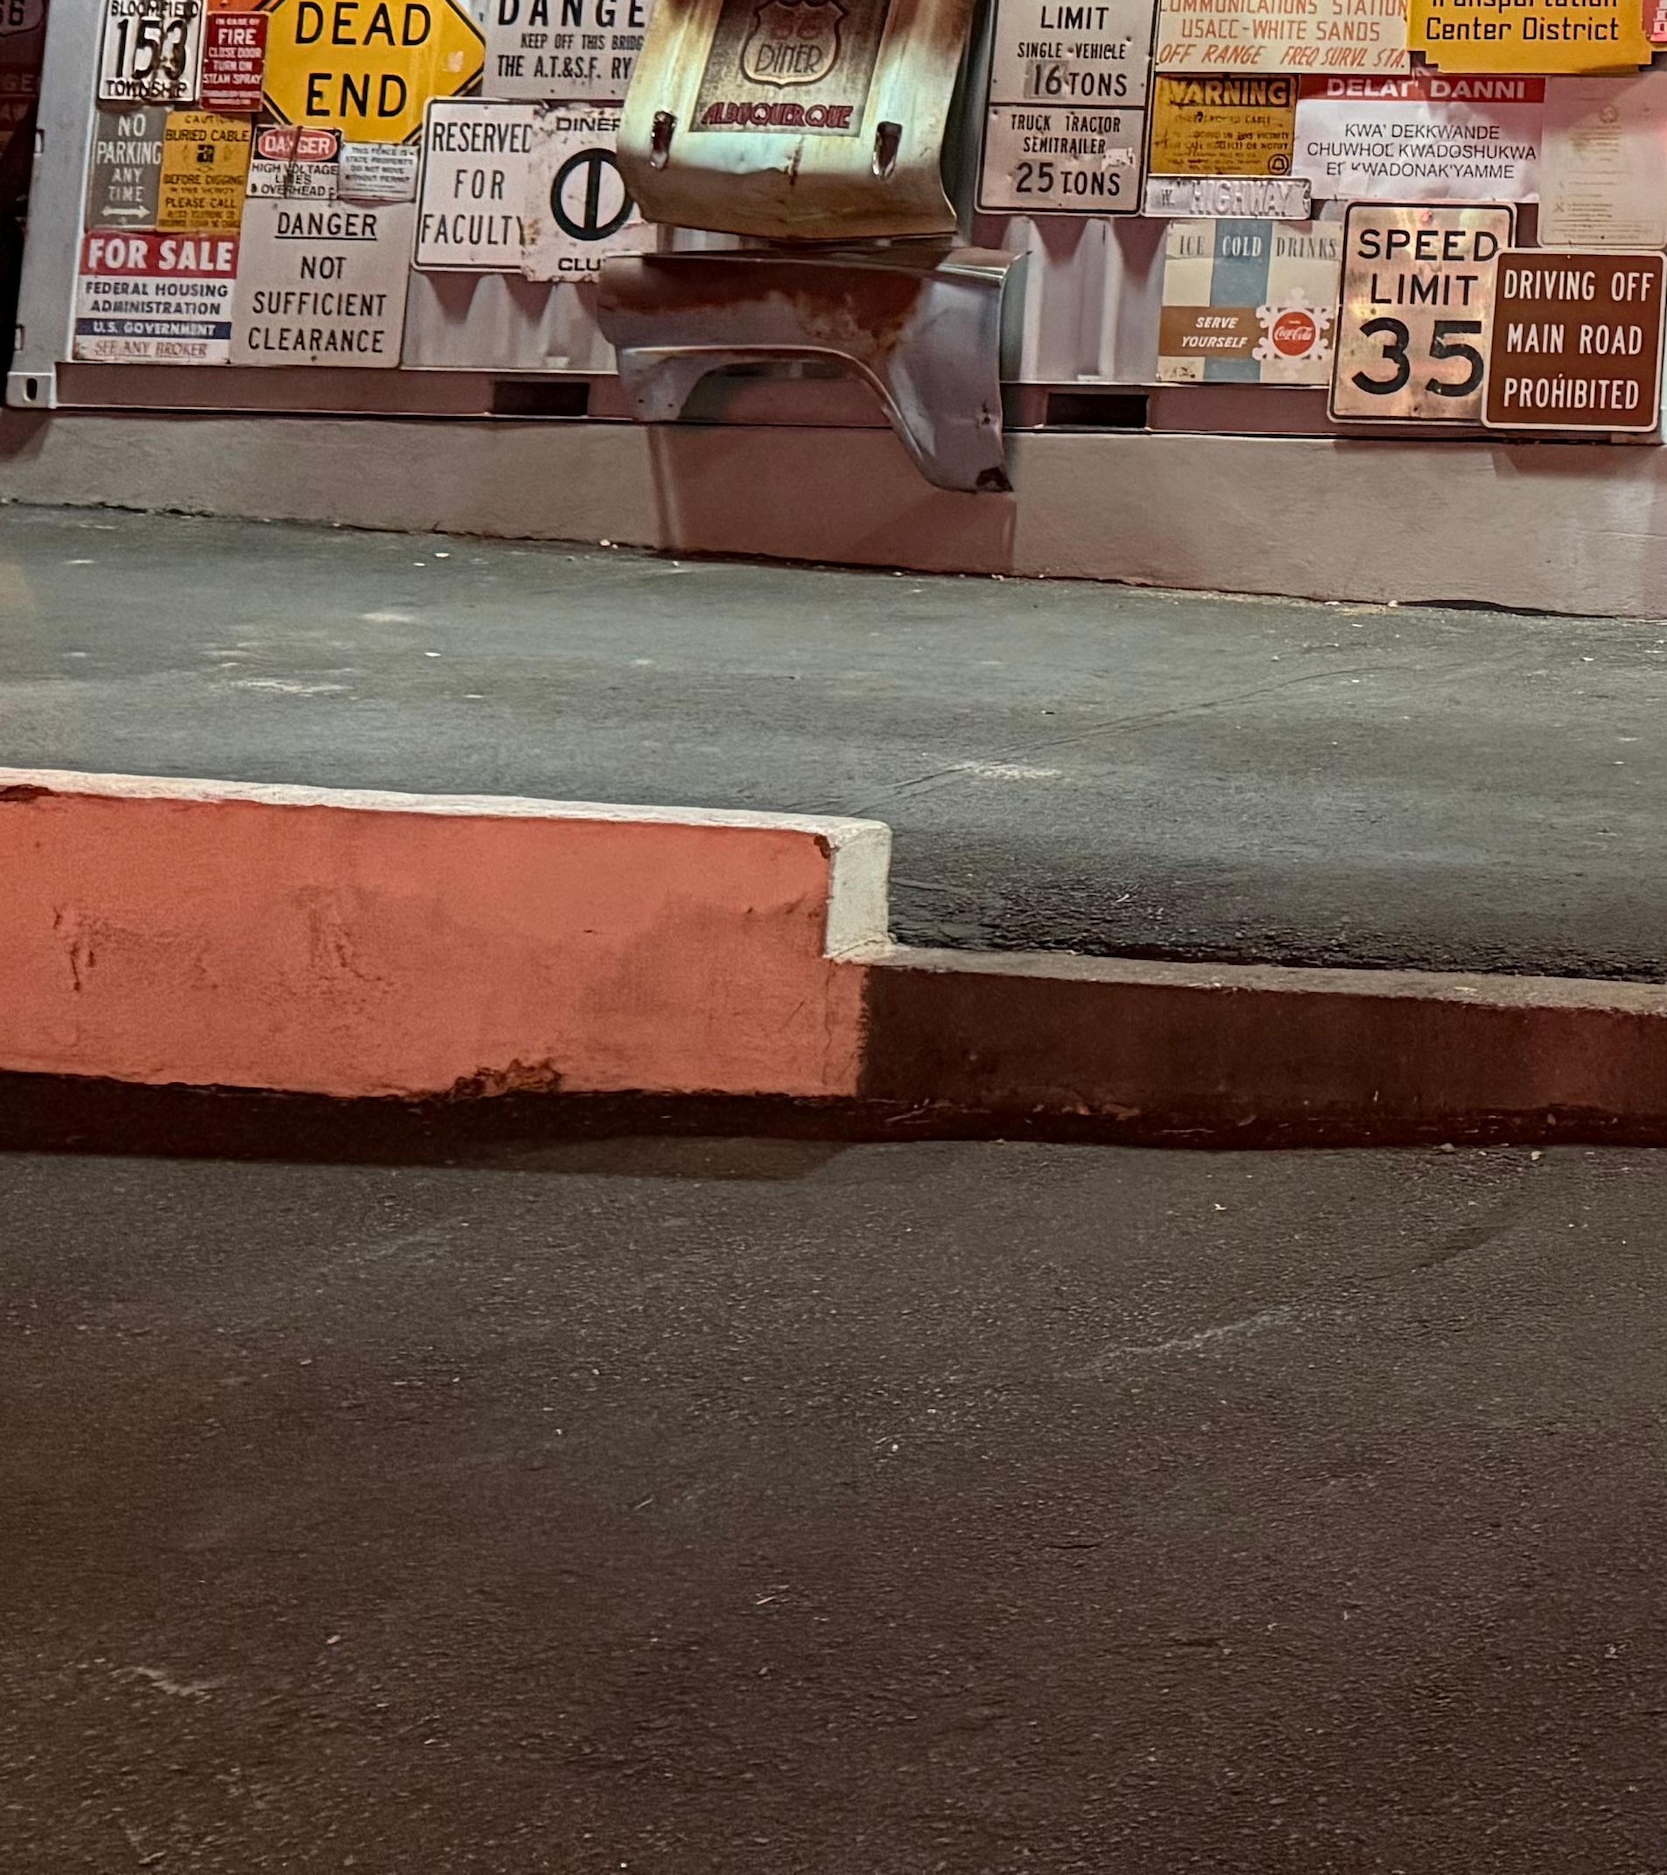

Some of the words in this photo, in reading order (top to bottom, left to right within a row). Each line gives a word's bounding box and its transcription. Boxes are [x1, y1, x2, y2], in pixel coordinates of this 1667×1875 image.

[295, 1, 432, 46] DEAD
[1426, 17, 1511, 40] Center
[1522, 17, 1619, 41] District
[306, 73, 407, 117] END
[277, 211, 377, 237] DANGER
[88, 238, 148, 270] FOR
[158, 241, 232, 271] SALE
[1359, 229, 1498, 261] SPEED
[300, 256, 346, 280] NOT
[86, 281, 148, 297] FEDERAL
[154, 283, 228, 298] HOUSING
[1372, 274, 1479, 306] LIMIT
[1504, 271, 1595, 301] DRIVING
[1611, 272, 1654, 301] OFF
[90, 300, 221, 316] ADMINISTRATION
[252, 291, 387, 317] SUFFICIENT
[1196, 315, 1238, 329] SERVE
[248, 327, 385, 353] CLEARANCE
[1182, 334, 1249, 349] YOURSELF
[1508, 325, 1562, 354] MAIN
[1579, 325, 1642, 356] ROAD
[1352, 317, 1484, 397] 35
[1504, 378, 1639, 410] PROHIBITED
